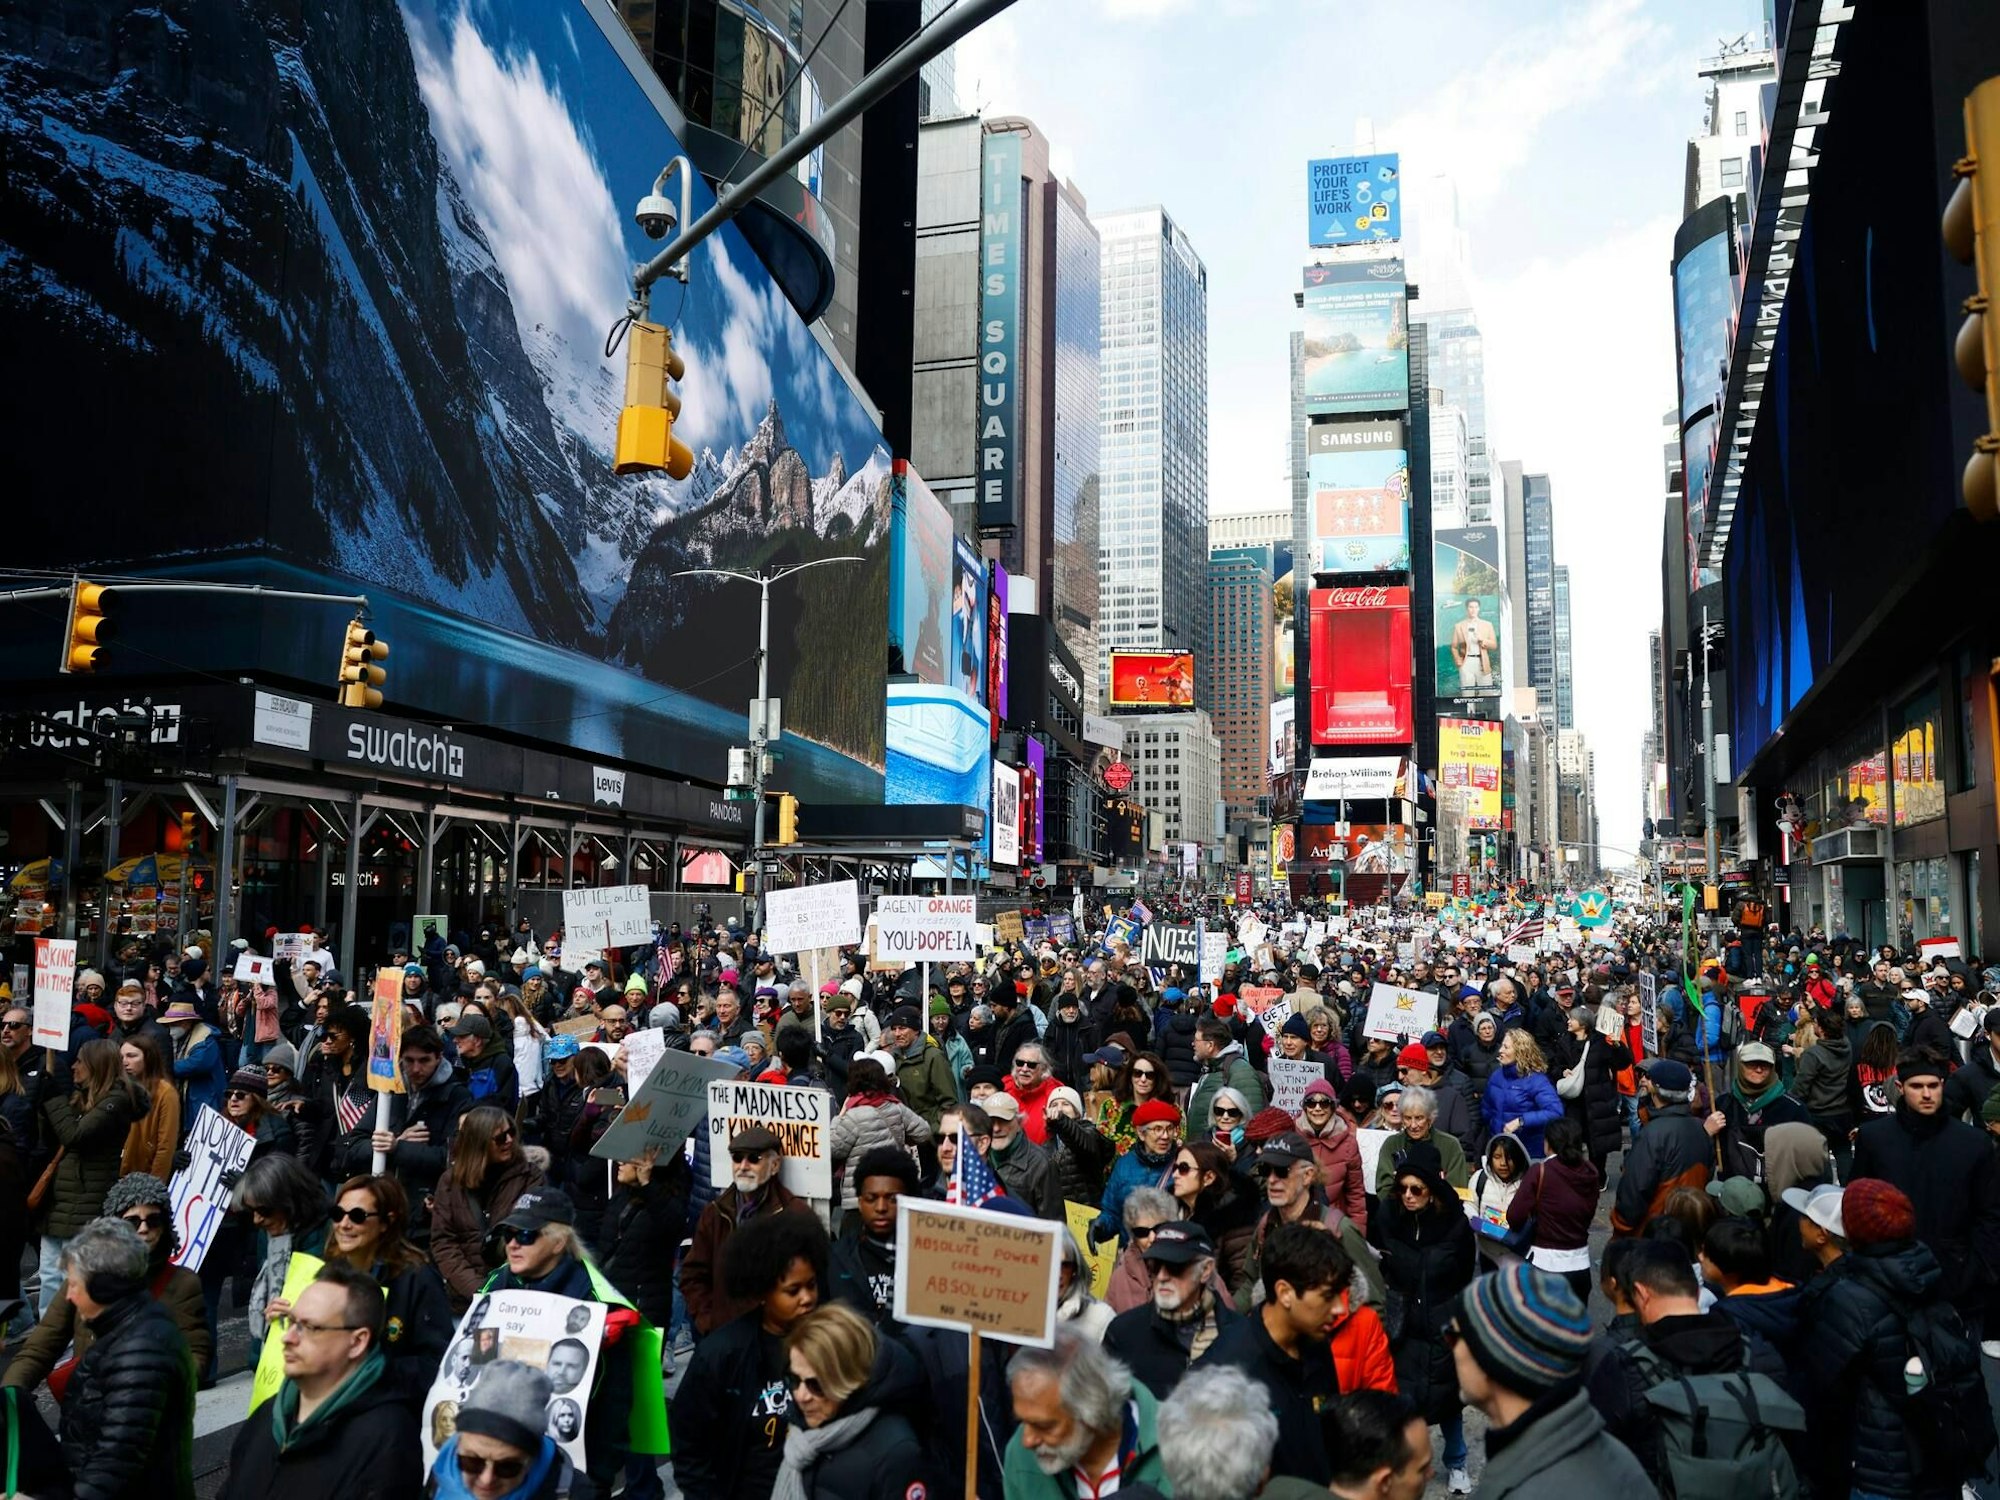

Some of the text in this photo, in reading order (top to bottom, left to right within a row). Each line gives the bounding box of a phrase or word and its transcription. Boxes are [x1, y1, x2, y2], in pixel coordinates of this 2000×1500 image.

[1313, 161, 1370, 177] PROTECT
[1313, 176, 1348, 189] YOUR
[1313, 189, 1350, 203] LIFE'S
[1313, 201, 1352, 215] WORK
[981, 153, 1009, 503] TIMES SQUARE
[1320, 430, 1393, 446] SAMSUNG
[1327, 585, 1390, 607] Coca-Cola
[347, 722, 448, 775] swatch
[1349, 768, 1392, 777] Williams
[709, 800, 743, 824] PANDORA
[1240, 875, 1249, 896] tkts
[1457, 876, 1468, 897] tkts
[564, 886, 645, 907] PUT ICE on ICE
[595, 906, 613, 918] and
[883, 899, 973, 914] AGENT ORANGE
[797, 912, 809, 924] BS
[570, 922, 606, 939] TRUMP
[618, 919, 649, 936] JAIL!
[1147, 923, 1178, 962] NO
[50, 947, 76, 968] KING
[36, 972, 73, 993] ANY TIME
[1262, 1003, 1287, 1022] GET
[653, 1068, 679, 1087] NO
[1272, 1062, 1321, 1074] KEEP YOUR
[1284, 1075, 1307, 1085] TINY
[669, 1101, 692, 1119] NO
[711, 1085, 819, 1122] THE MADNESS
[711, 1117, 725, 1135] OF
[187, 1104, 254, 1171] NO KING
[916, 1214, 1045, 1246] POWER CORRUPTS
[914, 1235, 1040, 1266] ABSOLUTE POWER
[951, 1260, 1004, 1278] CORRUPTS
[925, 1274, 1030, 1305] ABSOLUTELY
[498, 1300, 543, 1319] Can you
[939, 1303, 1003, 1326] NO KINGS!
[504, 1320, 526, 1335] say
[258, 1364, 278, 1386] NO
[767, 1379, 785, 1393] Las
